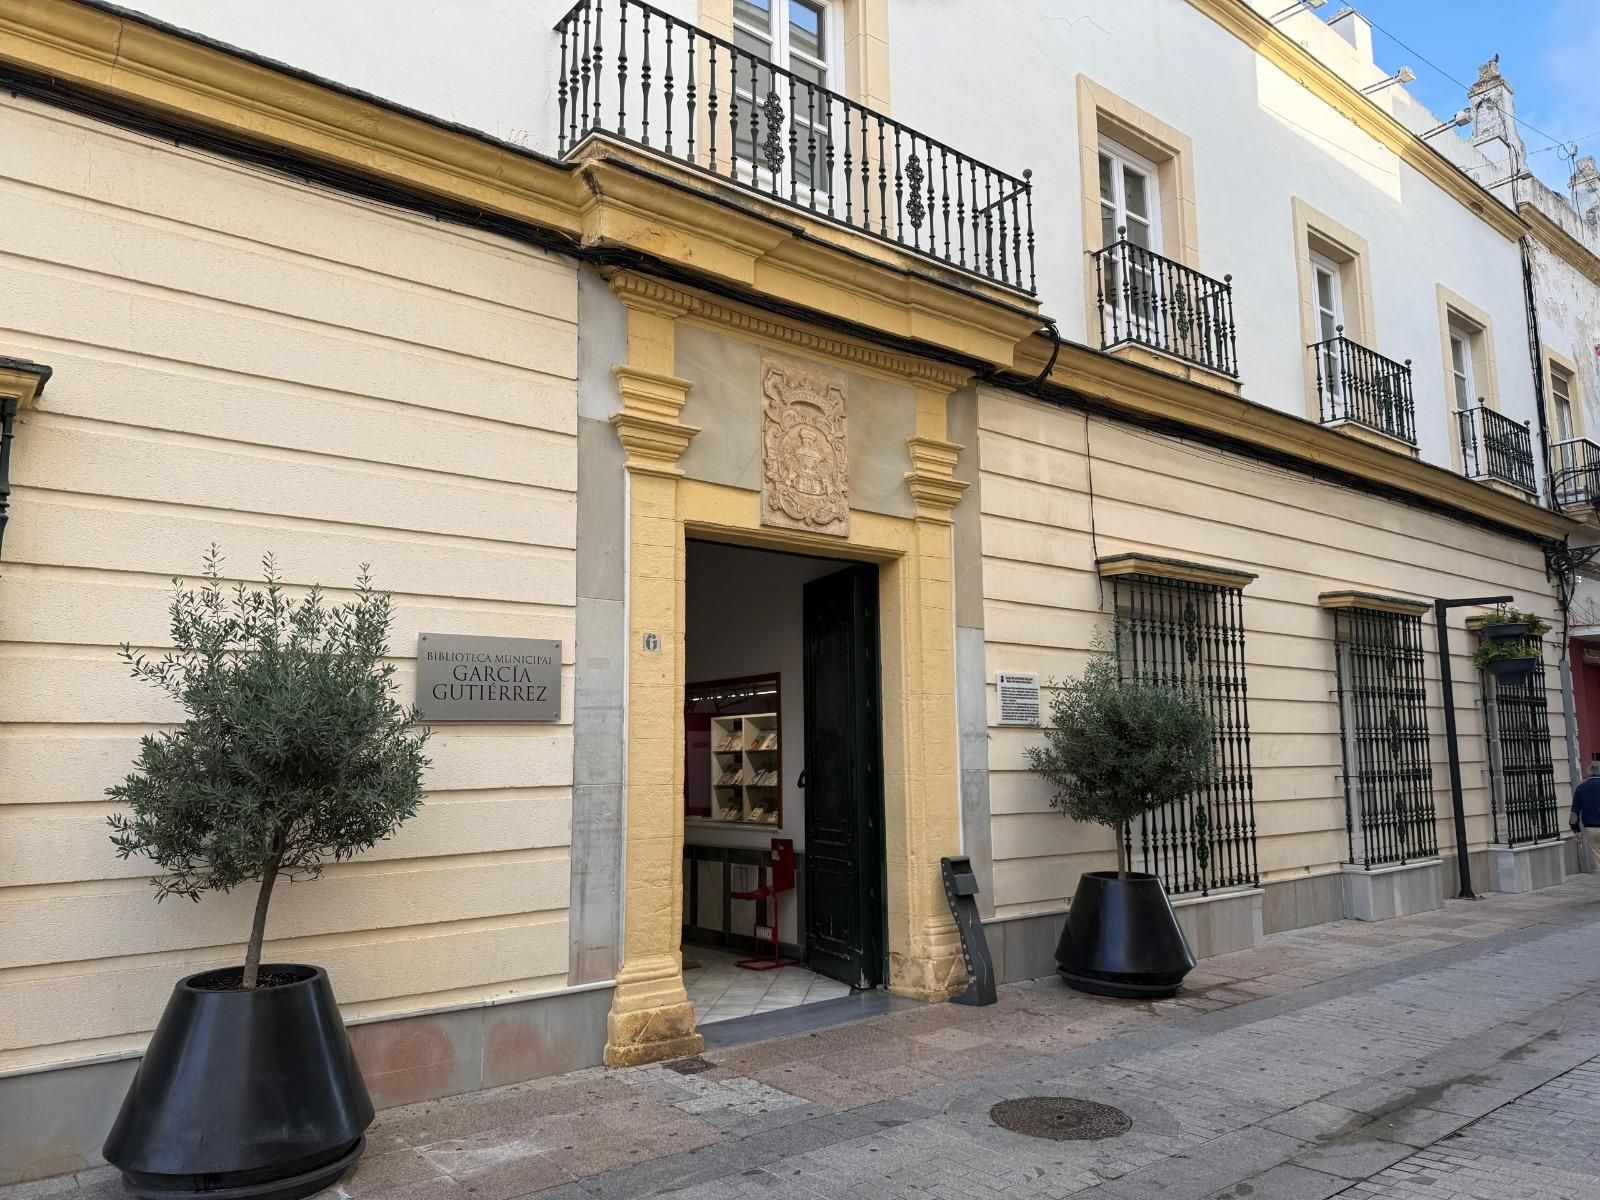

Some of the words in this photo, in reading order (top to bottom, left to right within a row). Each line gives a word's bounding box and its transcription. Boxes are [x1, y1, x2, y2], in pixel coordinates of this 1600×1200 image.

[427, 651, 491, 663] BIBLIOTECA
[494, 654, 553, 665] MUNICIPAL
[453, 664, 532, 683] GARCÍA
[432, 682, 548, 702] GUTIÉRREZ
